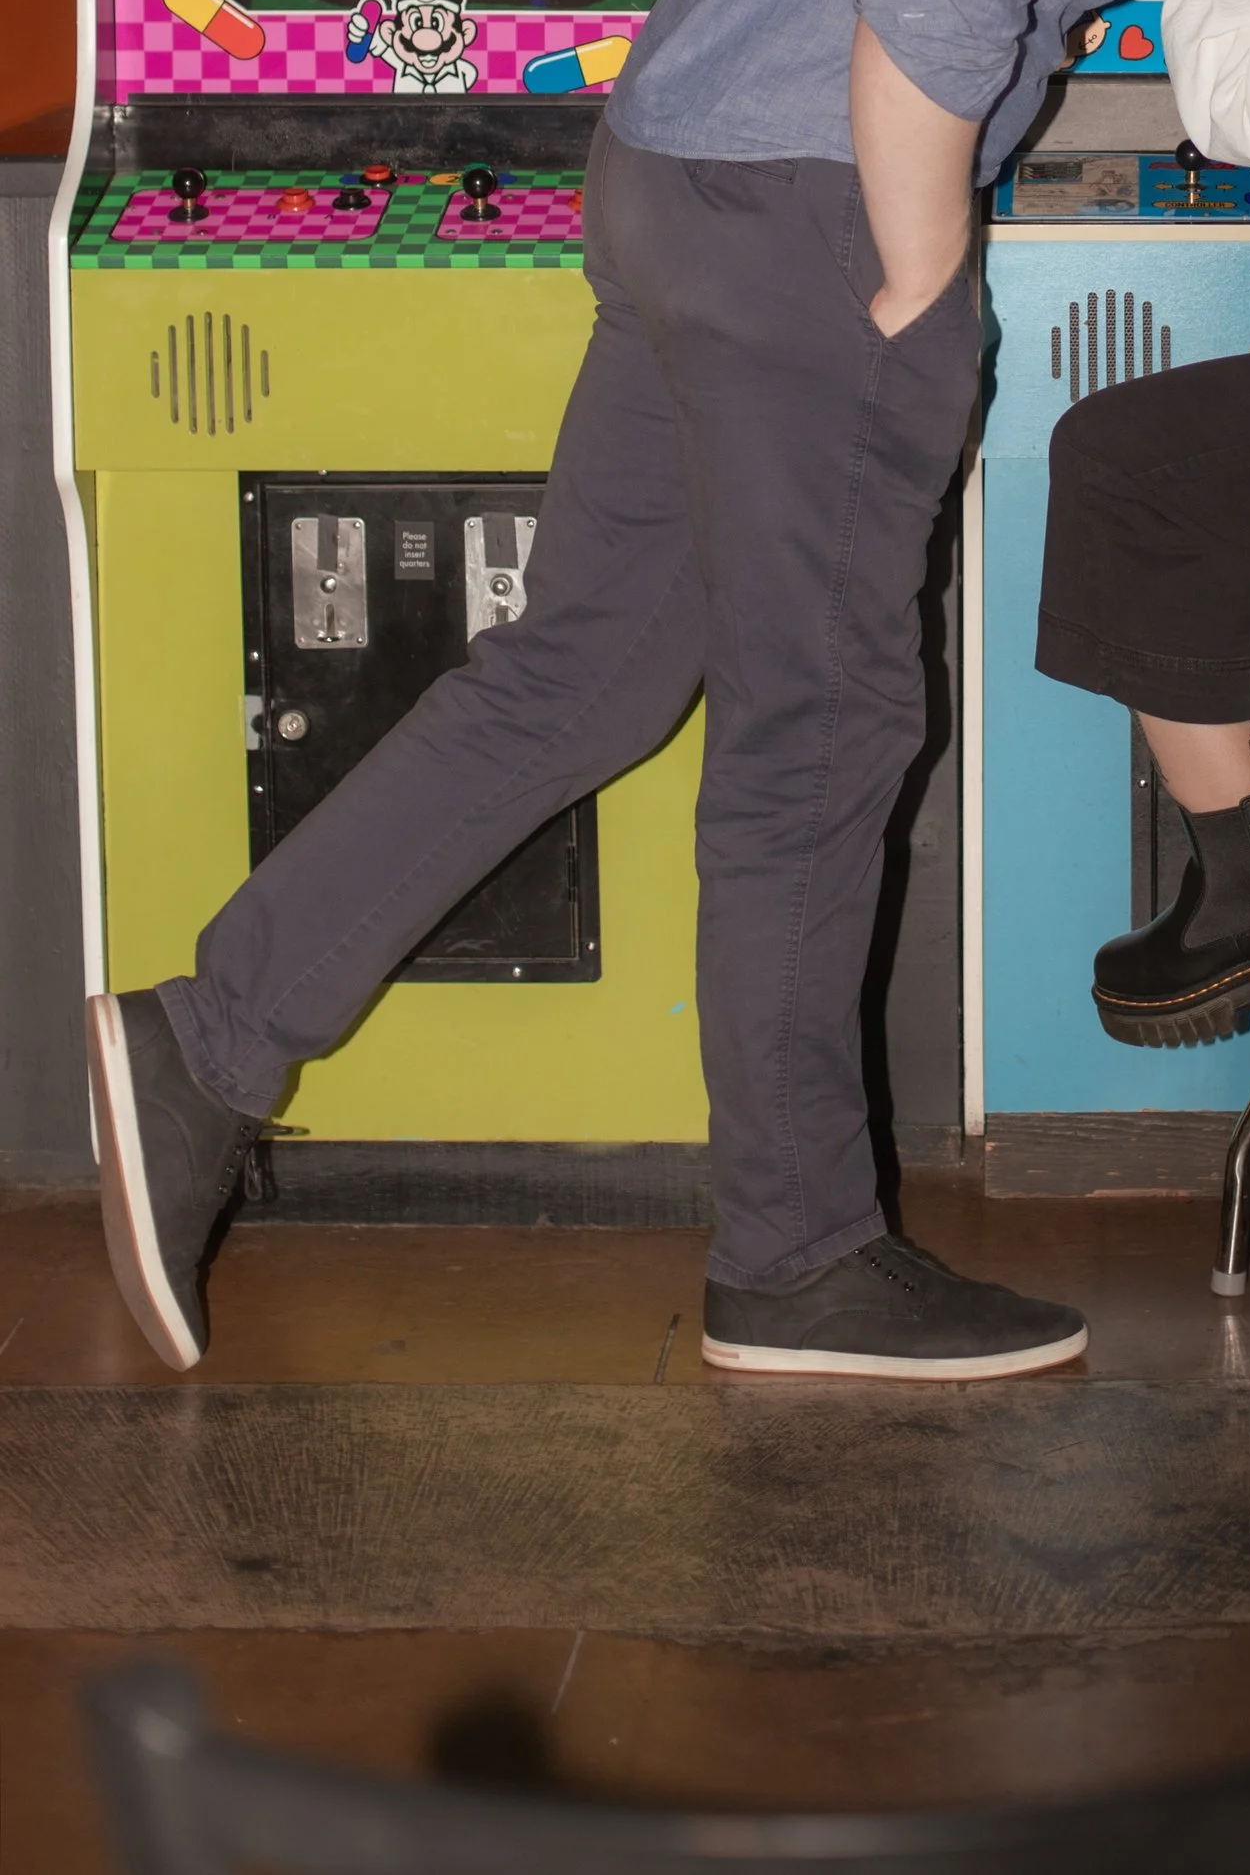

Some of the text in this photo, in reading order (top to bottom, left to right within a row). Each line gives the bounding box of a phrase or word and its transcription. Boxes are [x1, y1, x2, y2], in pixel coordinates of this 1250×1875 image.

[403, 532, 427, 540] Please
[402, 541, 413, 549] do
[400, 561, 430, 569] quarters
